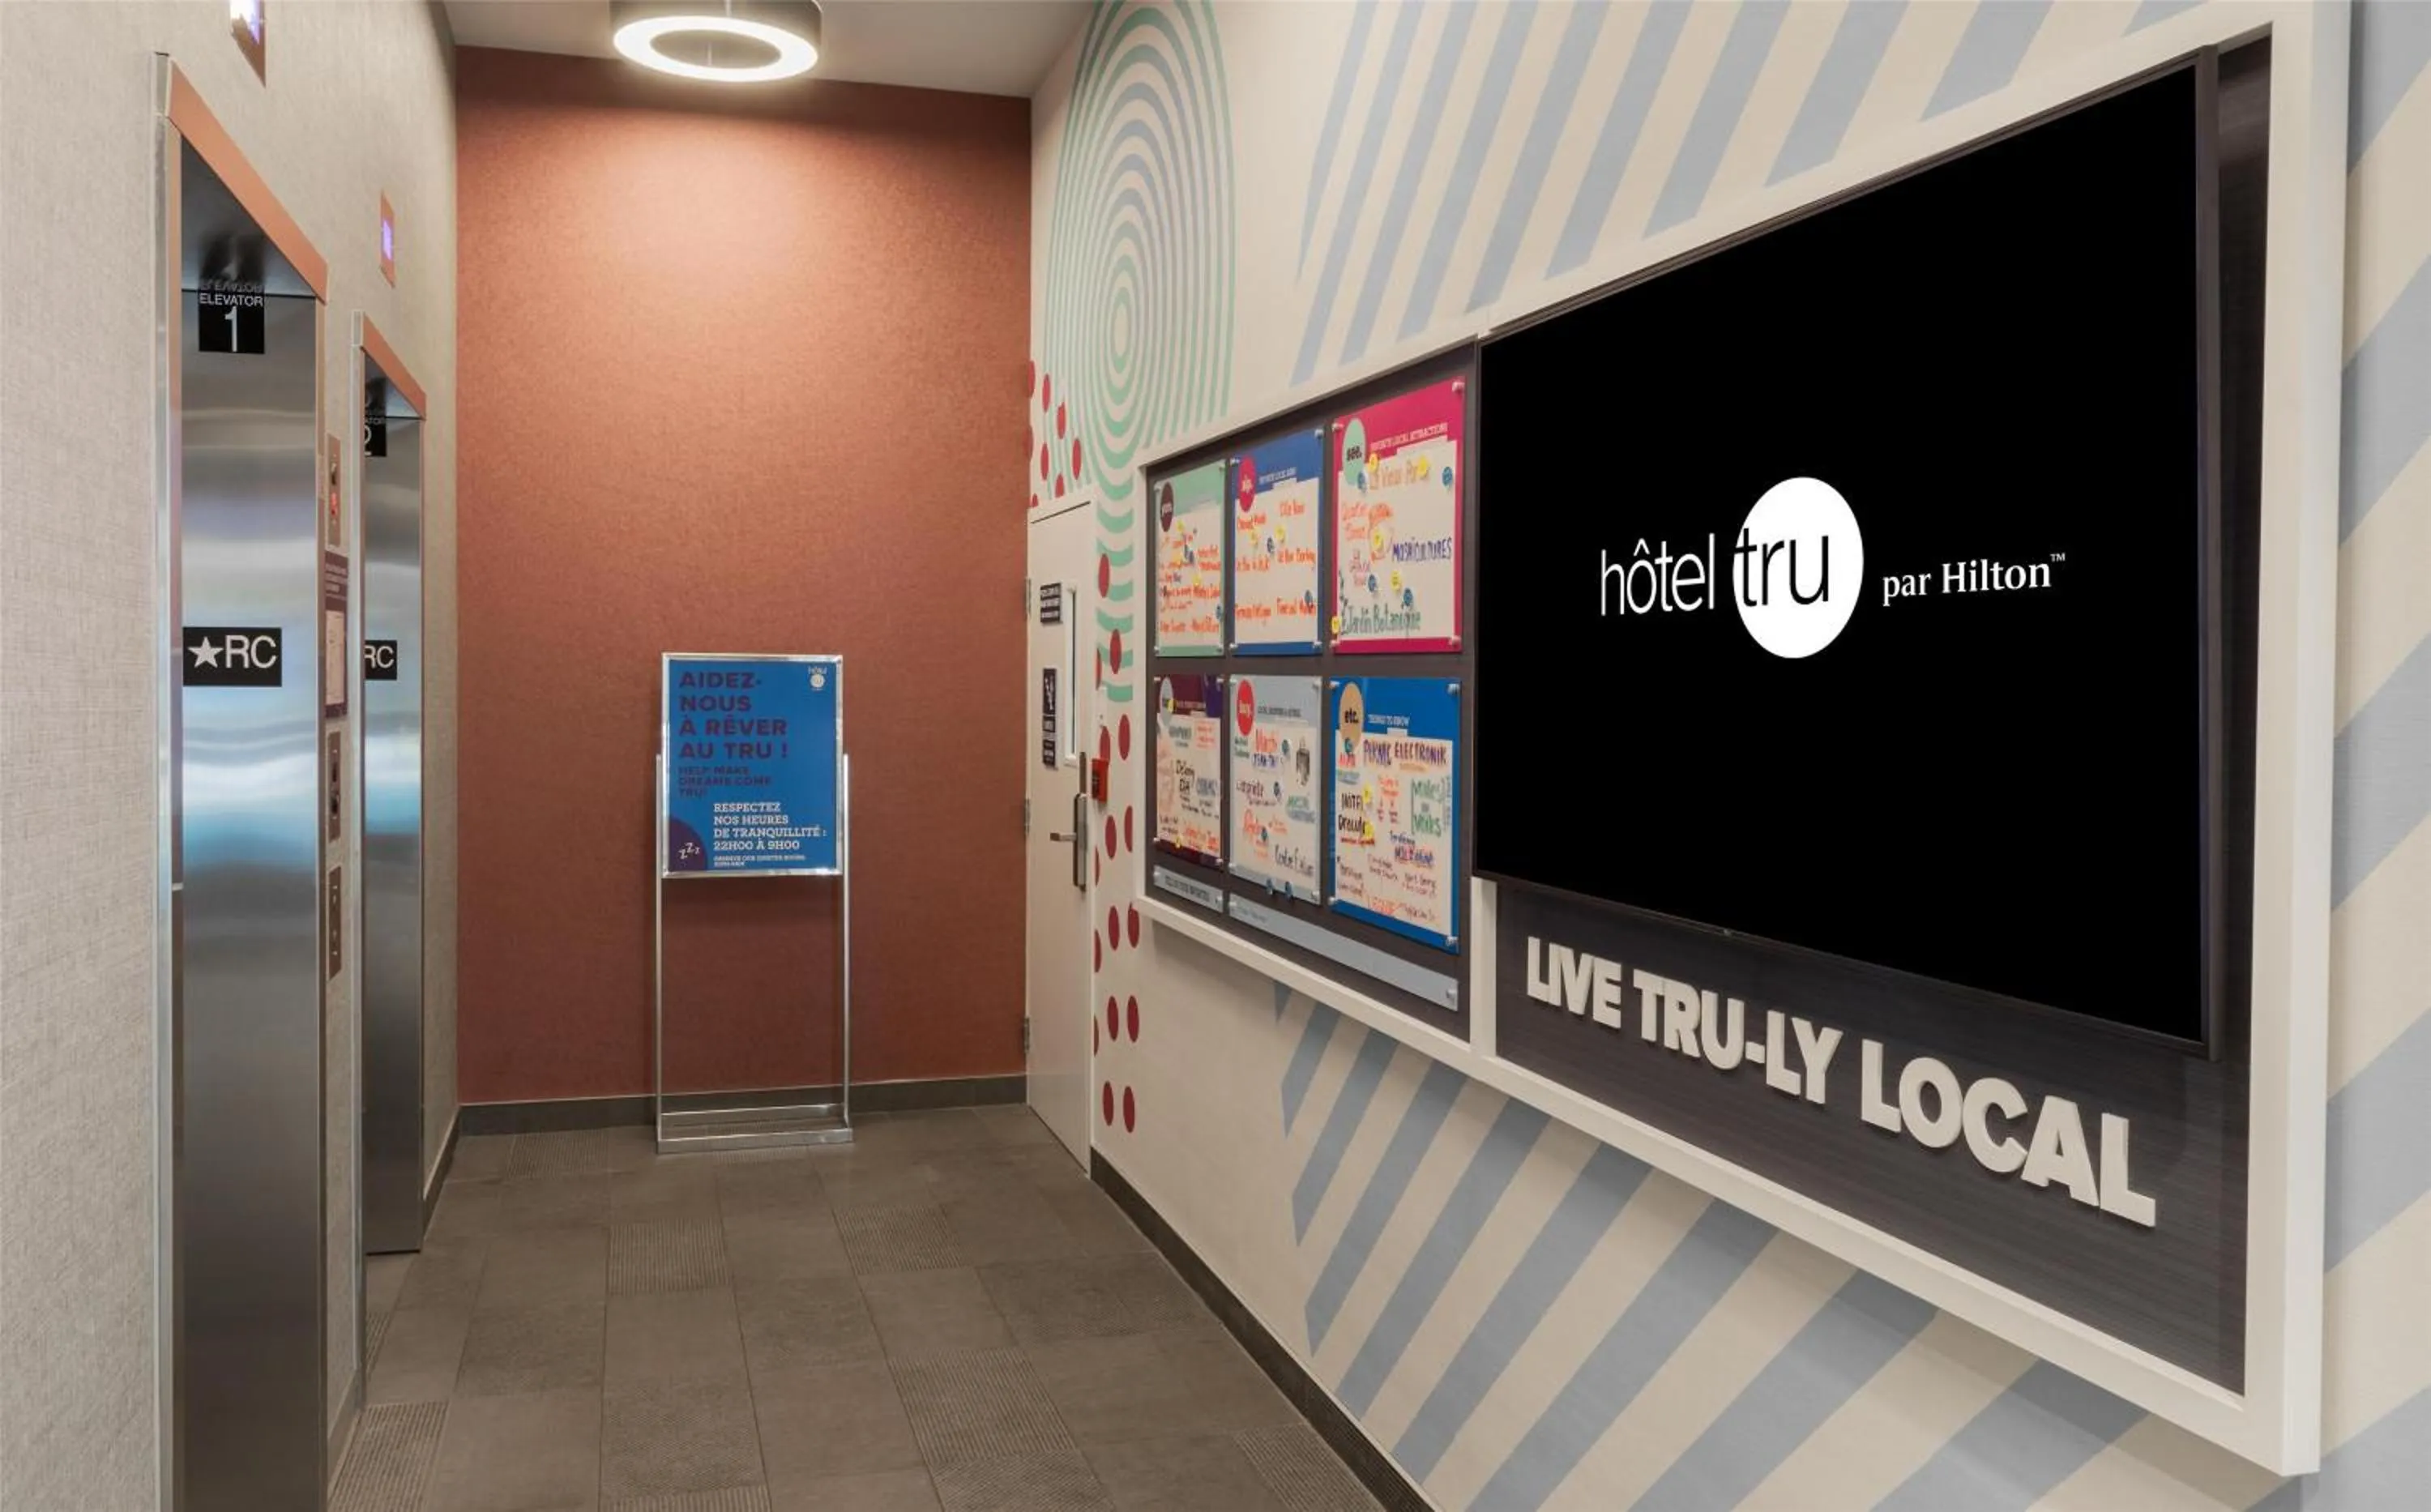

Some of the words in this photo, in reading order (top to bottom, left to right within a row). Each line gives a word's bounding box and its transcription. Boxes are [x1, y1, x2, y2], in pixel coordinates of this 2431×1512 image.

[199, 293, 263, 307] ELEVATOR
[224, 305, 237, 352] 1
[1601, 532, 1715, 616] hôtel
[1734, 527, 1831, 608] tru
[1882, 566, 1932, 607] par
[678, 672, 762, 689] AIDEZ-
[679, 694, 752, 712] NOUS
[1344, 708, 1360, 724] etc.
[678, 714, 696, 736] À
[705, 714, 787, 736] RÊVER
[678, 741, 714, 759] AU
[724, 741, 771, 759] TRU
[713, 802, 780, 813] RESPECTEZ
[713, 815, 739, 825] NOS
[741, 814, 788, 825] HEURES
[713, 828, 729, 838] DE
[732, 825, 820, 838] TRANQUILLITÉ
[713, 840, 754, 851] 22H00
[756, 837, 766, 851] À
[767, 840, 801, 851] 9H00
[1527, 937, 1621, 1029] LIVE
[1632, 968, 1843, 1105] TRU-LY
[1861, 1039, 2156, 1228] LOCAL
